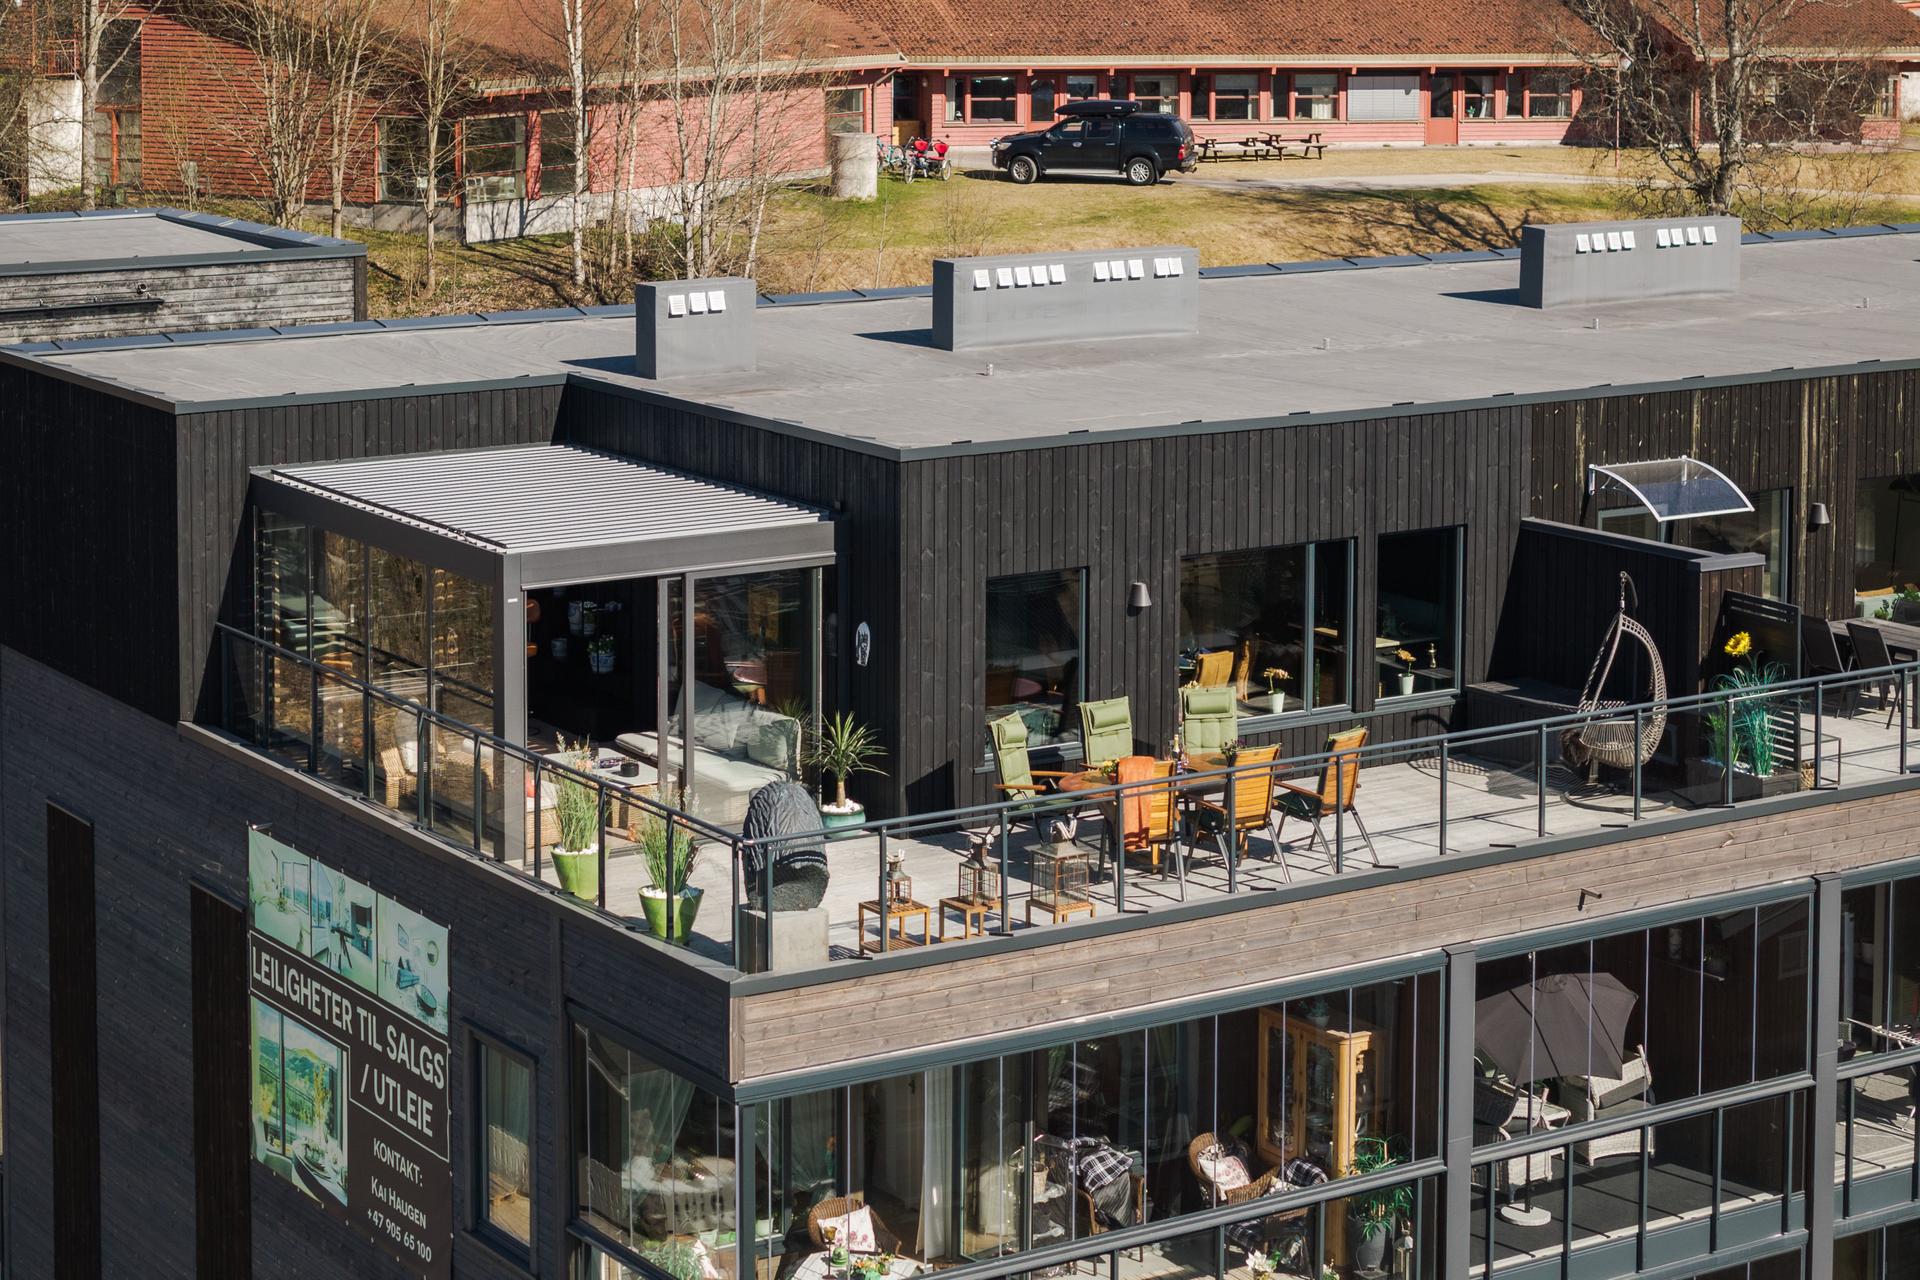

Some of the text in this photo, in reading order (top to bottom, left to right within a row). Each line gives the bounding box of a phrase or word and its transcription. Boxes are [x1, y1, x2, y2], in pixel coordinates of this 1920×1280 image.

[252, 945, 445, 1090] LEILIGHETER TIL SALGS
[360, 1063, 433, 1137] / UTLEIE
[373, 1137, 423, 1187] KONTAKT:
[367, 1208, 432, 1263] +47 905 65 100
[388, 1187, 427, 1230] HAUGEN
